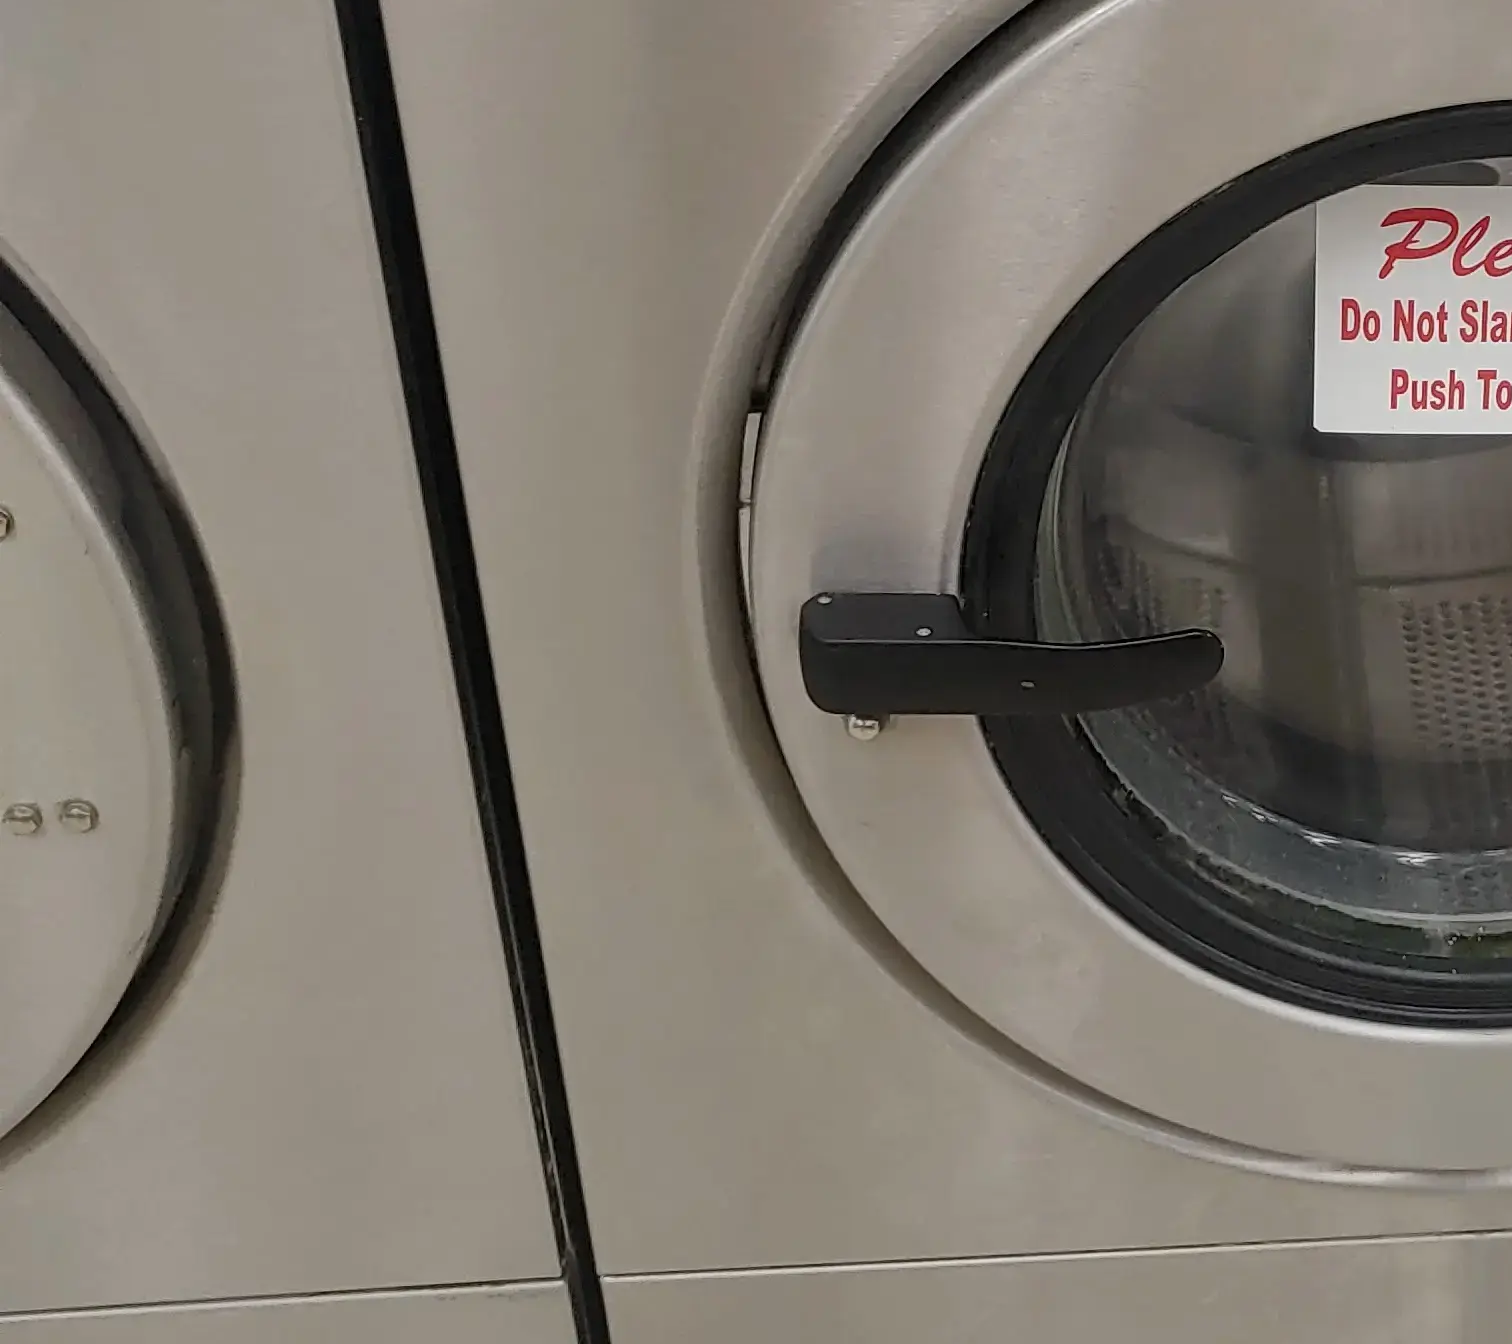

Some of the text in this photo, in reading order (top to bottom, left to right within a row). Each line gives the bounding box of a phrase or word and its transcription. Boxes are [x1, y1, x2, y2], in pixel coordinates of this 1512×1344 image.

[1341, 298, 1381, 342] Do
[1393, 299, 1448, 343] Not
[1390, 368, 1465, 410] Push
